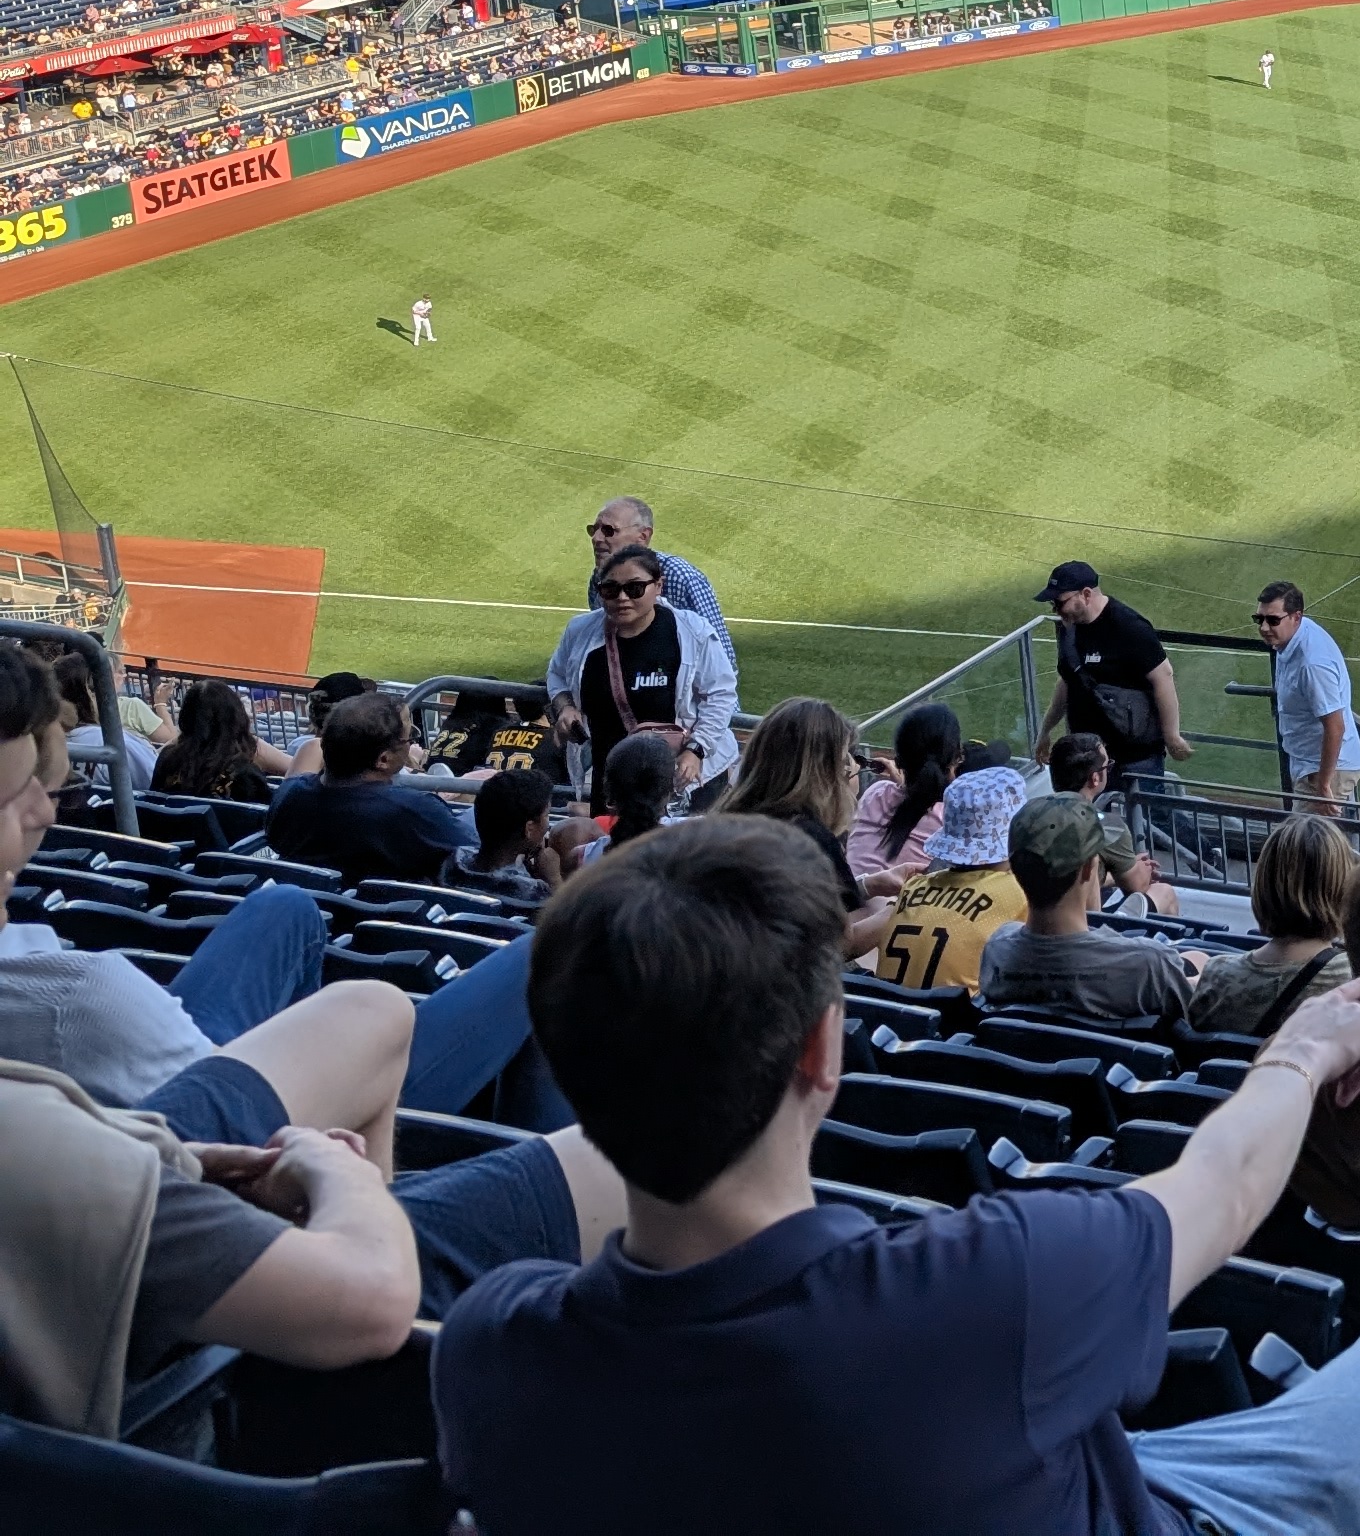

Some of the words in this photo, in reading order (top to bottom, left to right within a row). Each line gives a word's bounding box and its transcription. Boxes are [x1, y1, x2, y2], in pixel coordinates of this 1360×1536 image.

[549, 61, 631, 96] BETMGM
[370, 103, 469, 144] VANDA
[381, 126, 457, 152] PHARMACEUTICALS
[142, 148, 281, 214] SEATGEEK
[111, 213, 133, 228] 379
[630, 667, 669, 692] julia
[493, 729, 544, 750] SKENES
[897, 885, 993, 922] BEDNAR
[882, 924, 950, 991] 51
